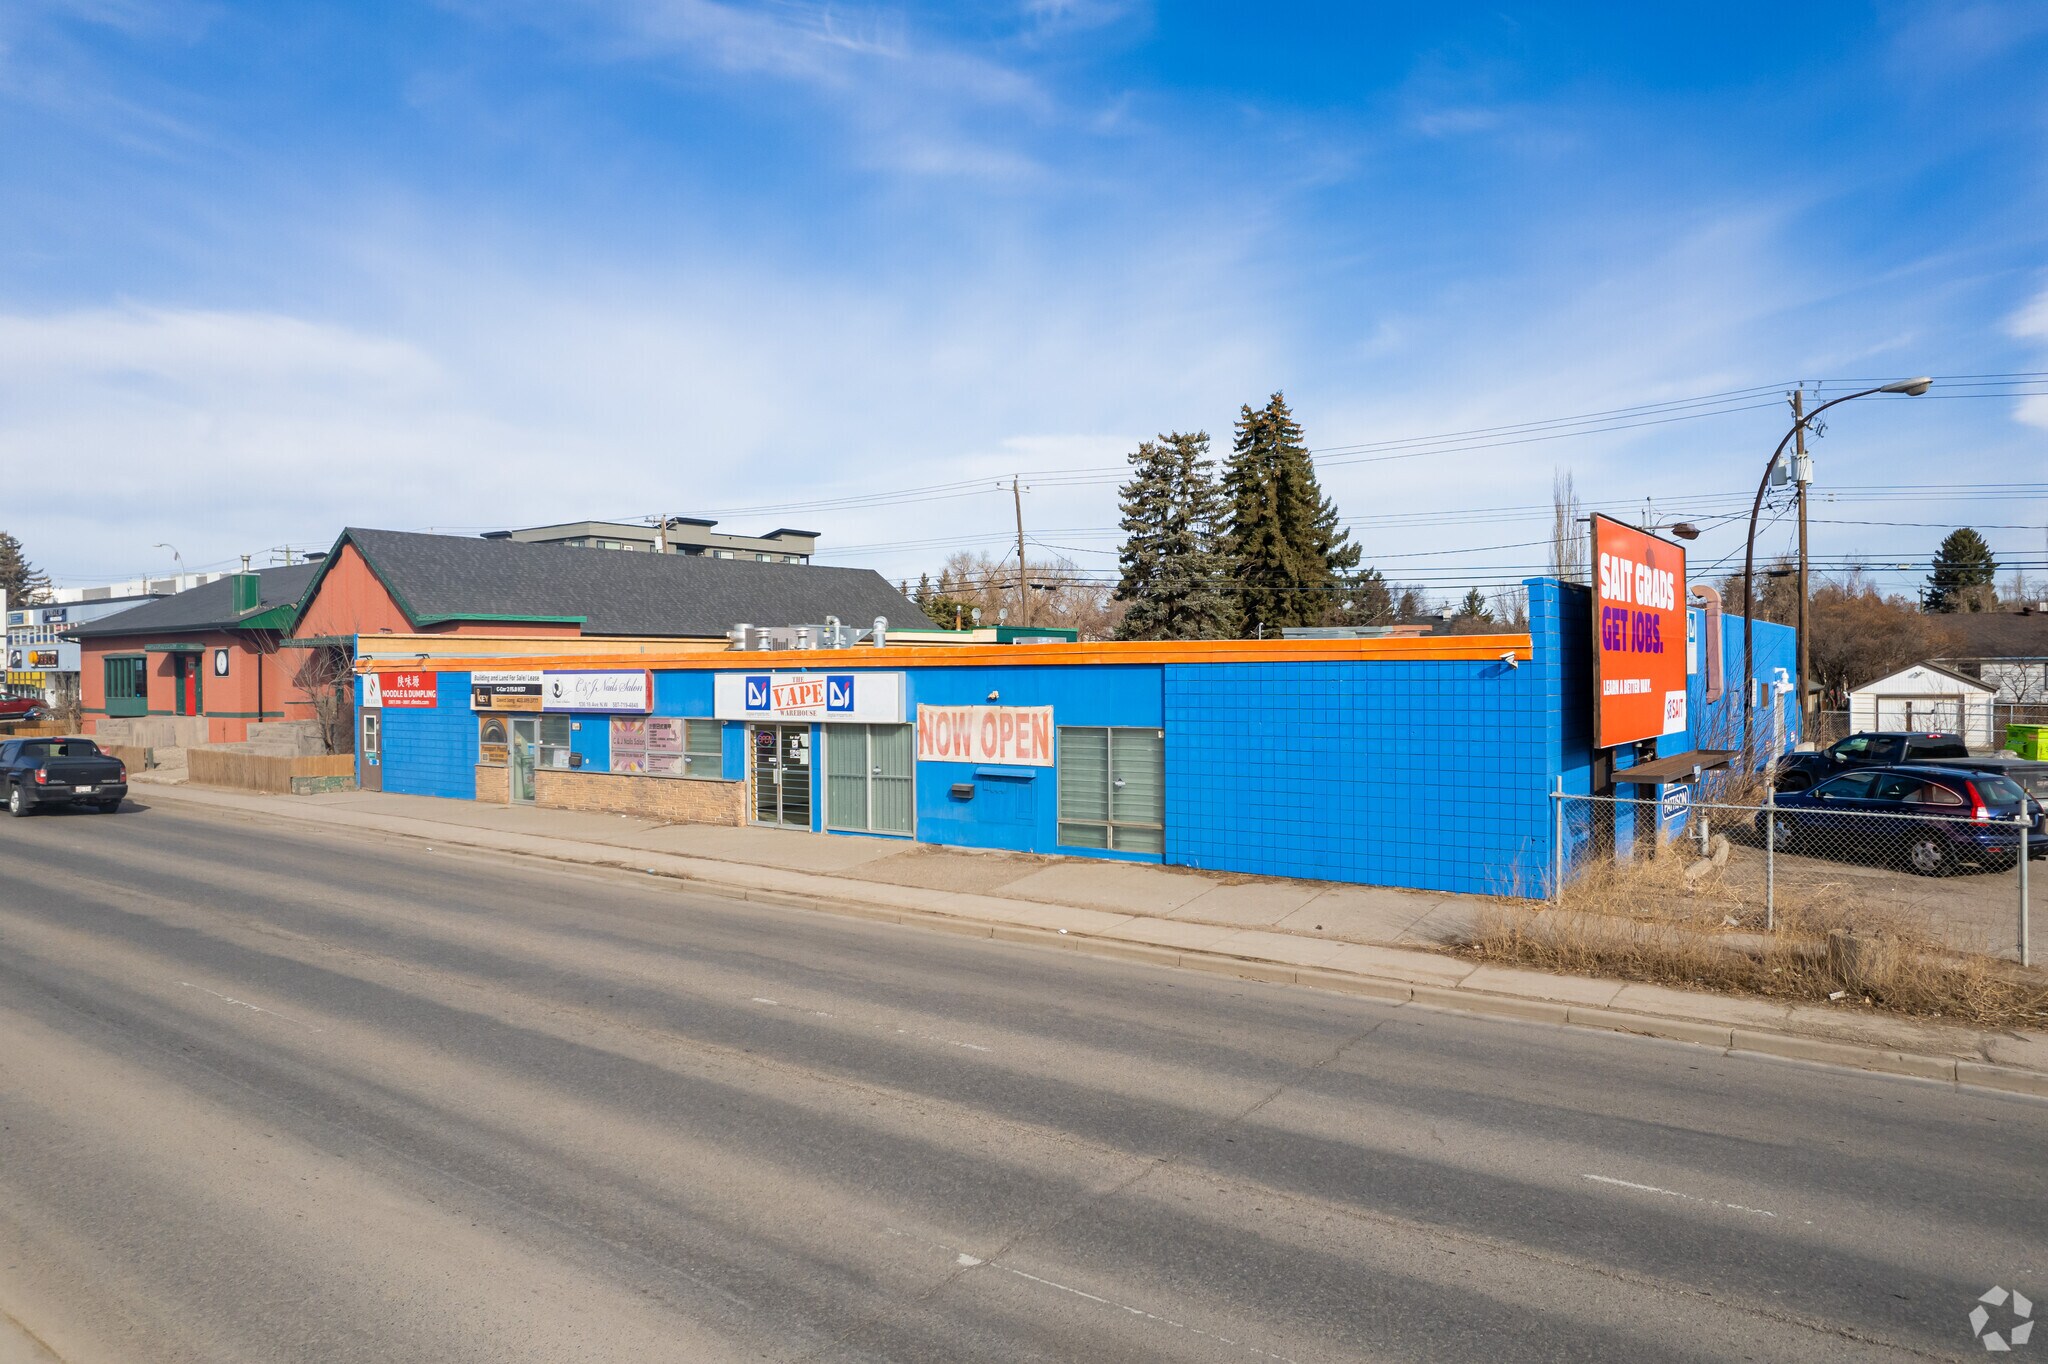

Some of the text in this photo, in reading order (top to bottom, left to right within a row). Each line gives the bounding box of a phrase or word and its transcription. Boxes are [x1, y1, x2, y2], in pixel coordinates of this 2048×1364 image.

[1600, 552, 1675, 612] SAIT GRADS
[1602, 606, 1664, 654] GET JOBS.
[474, 674, 490, 683] Building
[490, 674, 498, 682] and
[499, 674, 508, 682] Land
[528, 675, 540, 683] Lease
[597, 676, 618, 692] Nails
[619, 677, 643, 692] Salon
[1603, 679, 1620, 696] LEARN
[1620, 680, 1624, 695] A
[1624, 679, 1640, 695] BETTER
[382, 689, 436, 698] NOODLE & DUMPLING
[477, 694, 489, 702] KEY
[772, 683, 824, 707] VAPE
[1672, 698, 1684, 719] SAIT
[634, 738, 645, 746] Salon
[919, 711, 1049, 760] NOW OPEN
[1664, 791, 1687, 814] PATTISON
